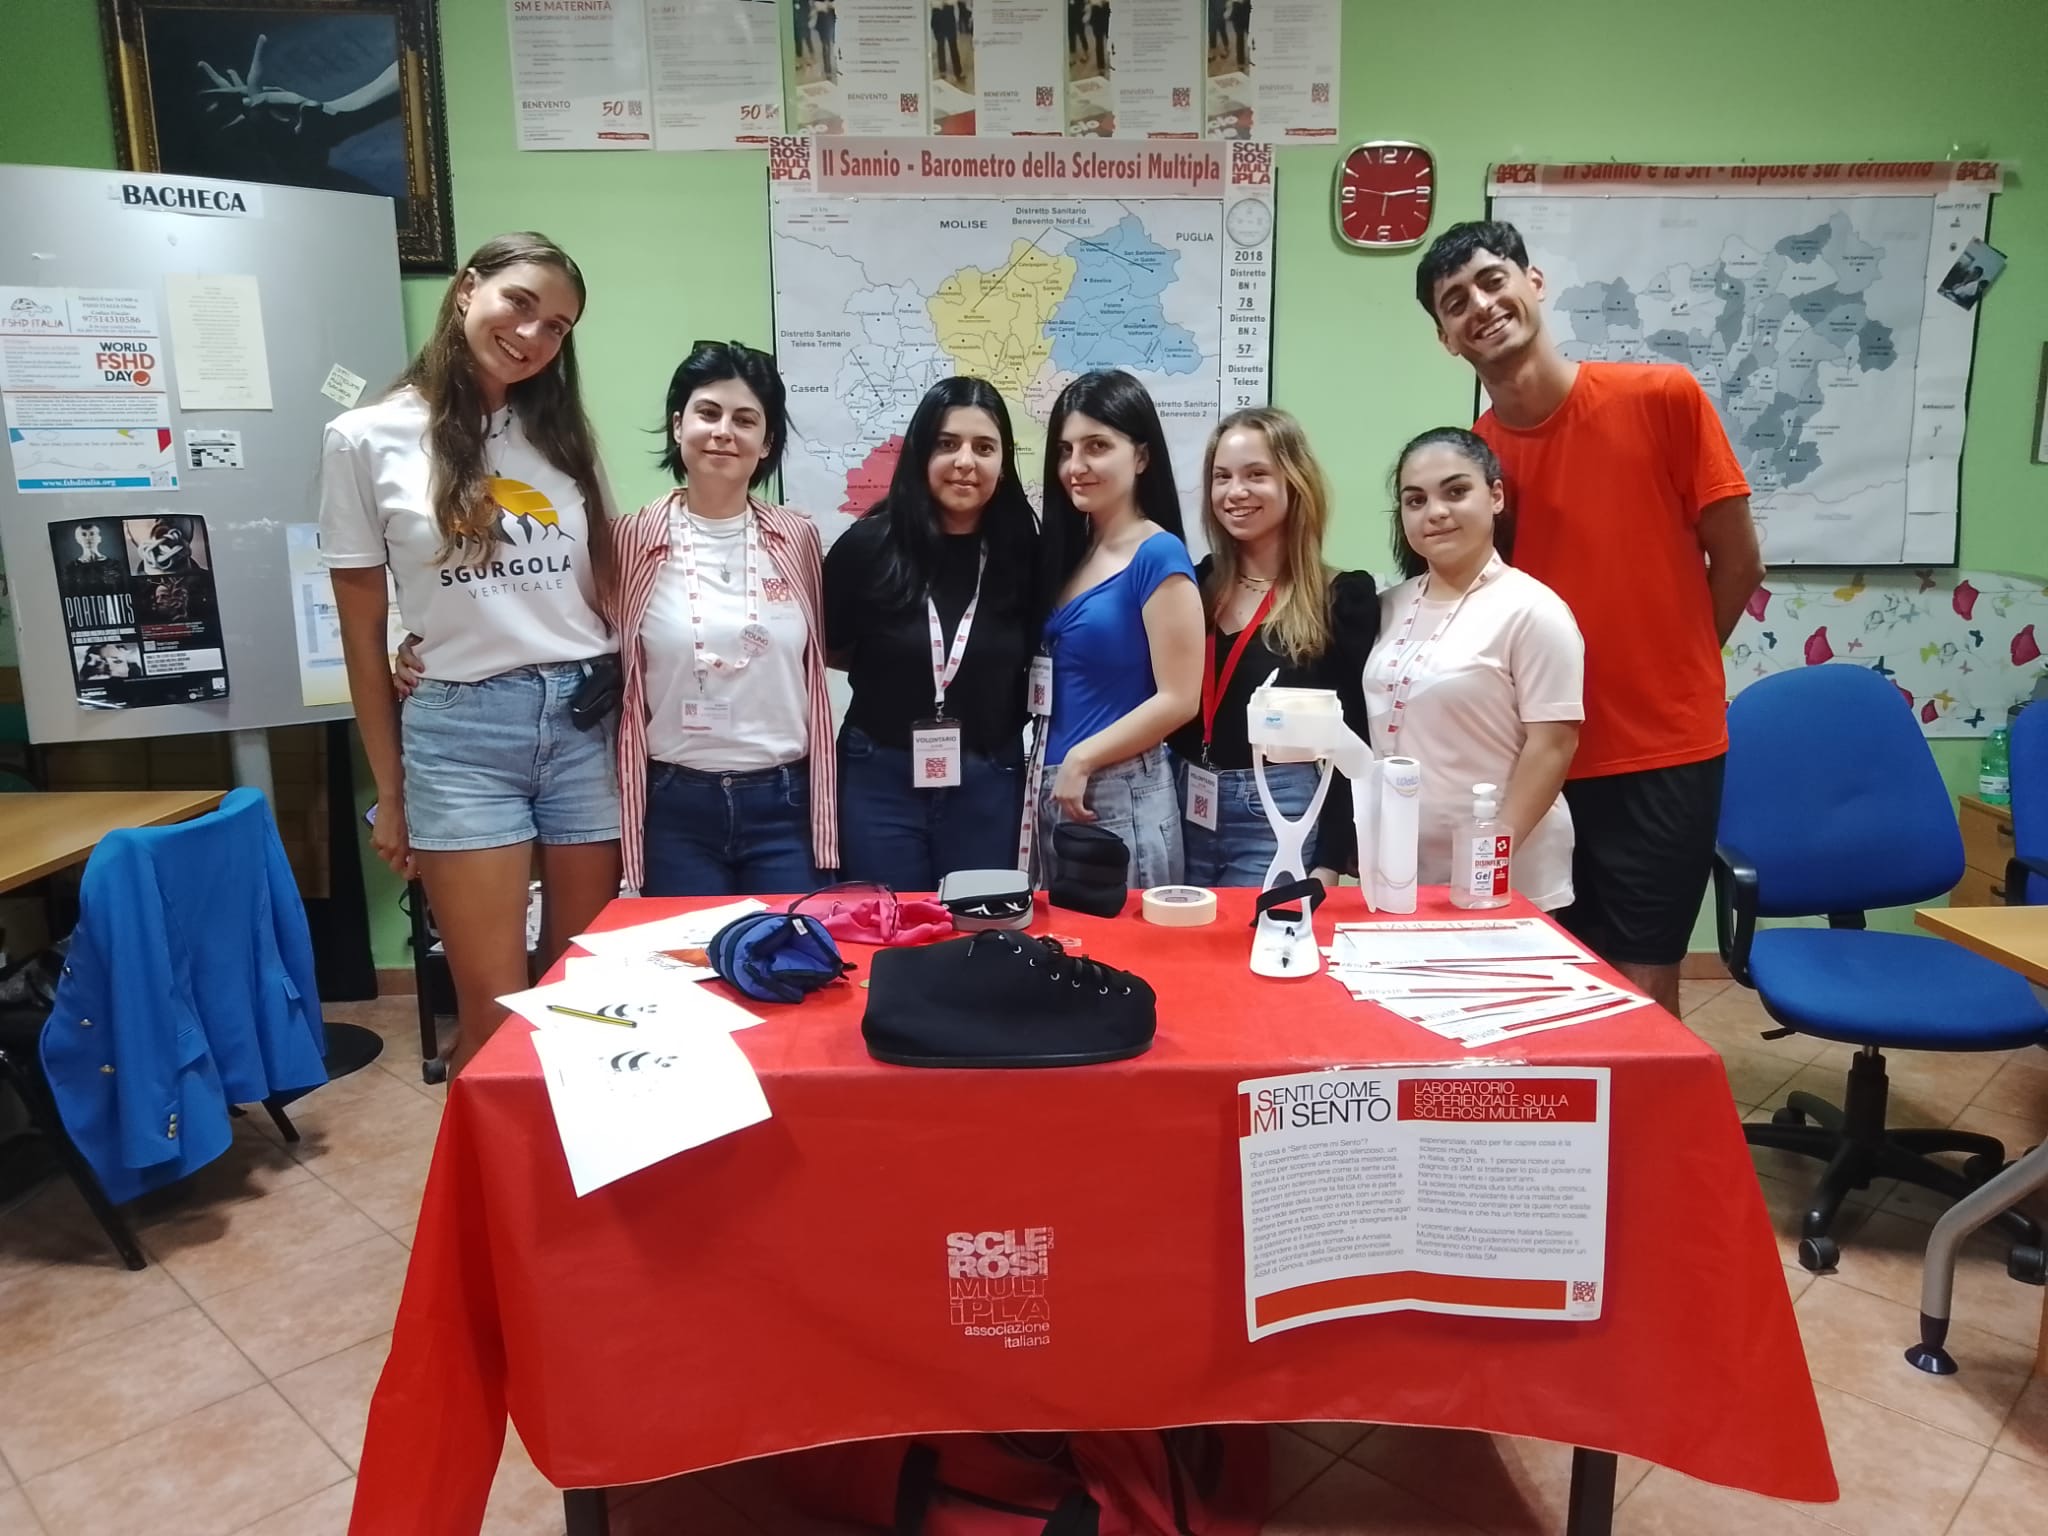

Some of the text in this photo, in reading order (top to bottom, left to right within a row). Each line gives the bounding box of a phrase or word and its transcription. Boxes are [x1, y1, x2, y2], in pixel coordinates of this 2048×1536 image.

[515, 2, 531, 11] SM
[535, 2, 541, 11] E
[602, 101, 623, 116] 50
[741, 104, 760, 120] 50
[770, 136, 810, 147] SCLE
[1233, 142, 1272, 152] SCLE
[1379, 148, 1398, 164] 12
[771, 158, 809, 169] MULT
[840, 149, 900, 176] Sannio
[922, 150, 1016, 177] Barometro
[1022, 151, 1066, 178] della
[1072, 152, 1141, 179] Sclerosi
[1149, 153, 1219, 187] Multipla
[1232, 163, 1271, 173] MULT
[122, 184, 246, 212] BACHECA
[1342, 186, 1356, 203] 9
[1416, 186, 1431, 202] 3
[1015, 207, 1049, 215] Distretto
[939, 220, 988, 229] MOLISE
[1056, 217, 1090, 225] Nord-Est
[1176, 232, 1213, 242] PUGLIA
[1377, 225, 1392, 241] 6
[1234, 251, 1263, 261] 2018
[1230, 269, 1266, 277] Distretto
[1239, 298, 1253, 308] 78
[2, 318, 64, 328] FSHD ITALIA
[1230, 314, 1265, 322] Distretto
[100, 342, 147, 352] WORLD
[1238, 344, 1251, 354] 57
[96, 353, 155, 370] FSHD
[105, 371, 133, 382] DAY
[1233, 378, 1259, 386] Telese
[790, 385, 829, 394] Caserta
[1237, 396, 1250, 406] 52
[440, 555, 572, 587] SGURGOLA
[468, 579, 563, 599] VERTICALE
[65, 593, 135, 627] PORTRAITS
[744, 629, 769, 645] YOUNG
[915, 735, 957, 744] VOLONTARIO
[1475, 871, 1492, 880] Gel
[1415, 1081, 1514, 1094] LABORATORIO
[1257, 1081, 1381, 1111] SENTI COME
[1414, 1094, 1568, 1107] ESPERIENZIALE SULLA
[1254, 1098, 1391, 1134] MI SENTO
[1414, 1106, 1556, 1119] SCLEROSI MULTIPLA
[946, 1227, 1047, 1256] SCLE
[949, 1275, 1048, 1299] MULT
[964, 1322, 1049, 1336] associazione
[1004, 1335, 1050, 1348] italiana
